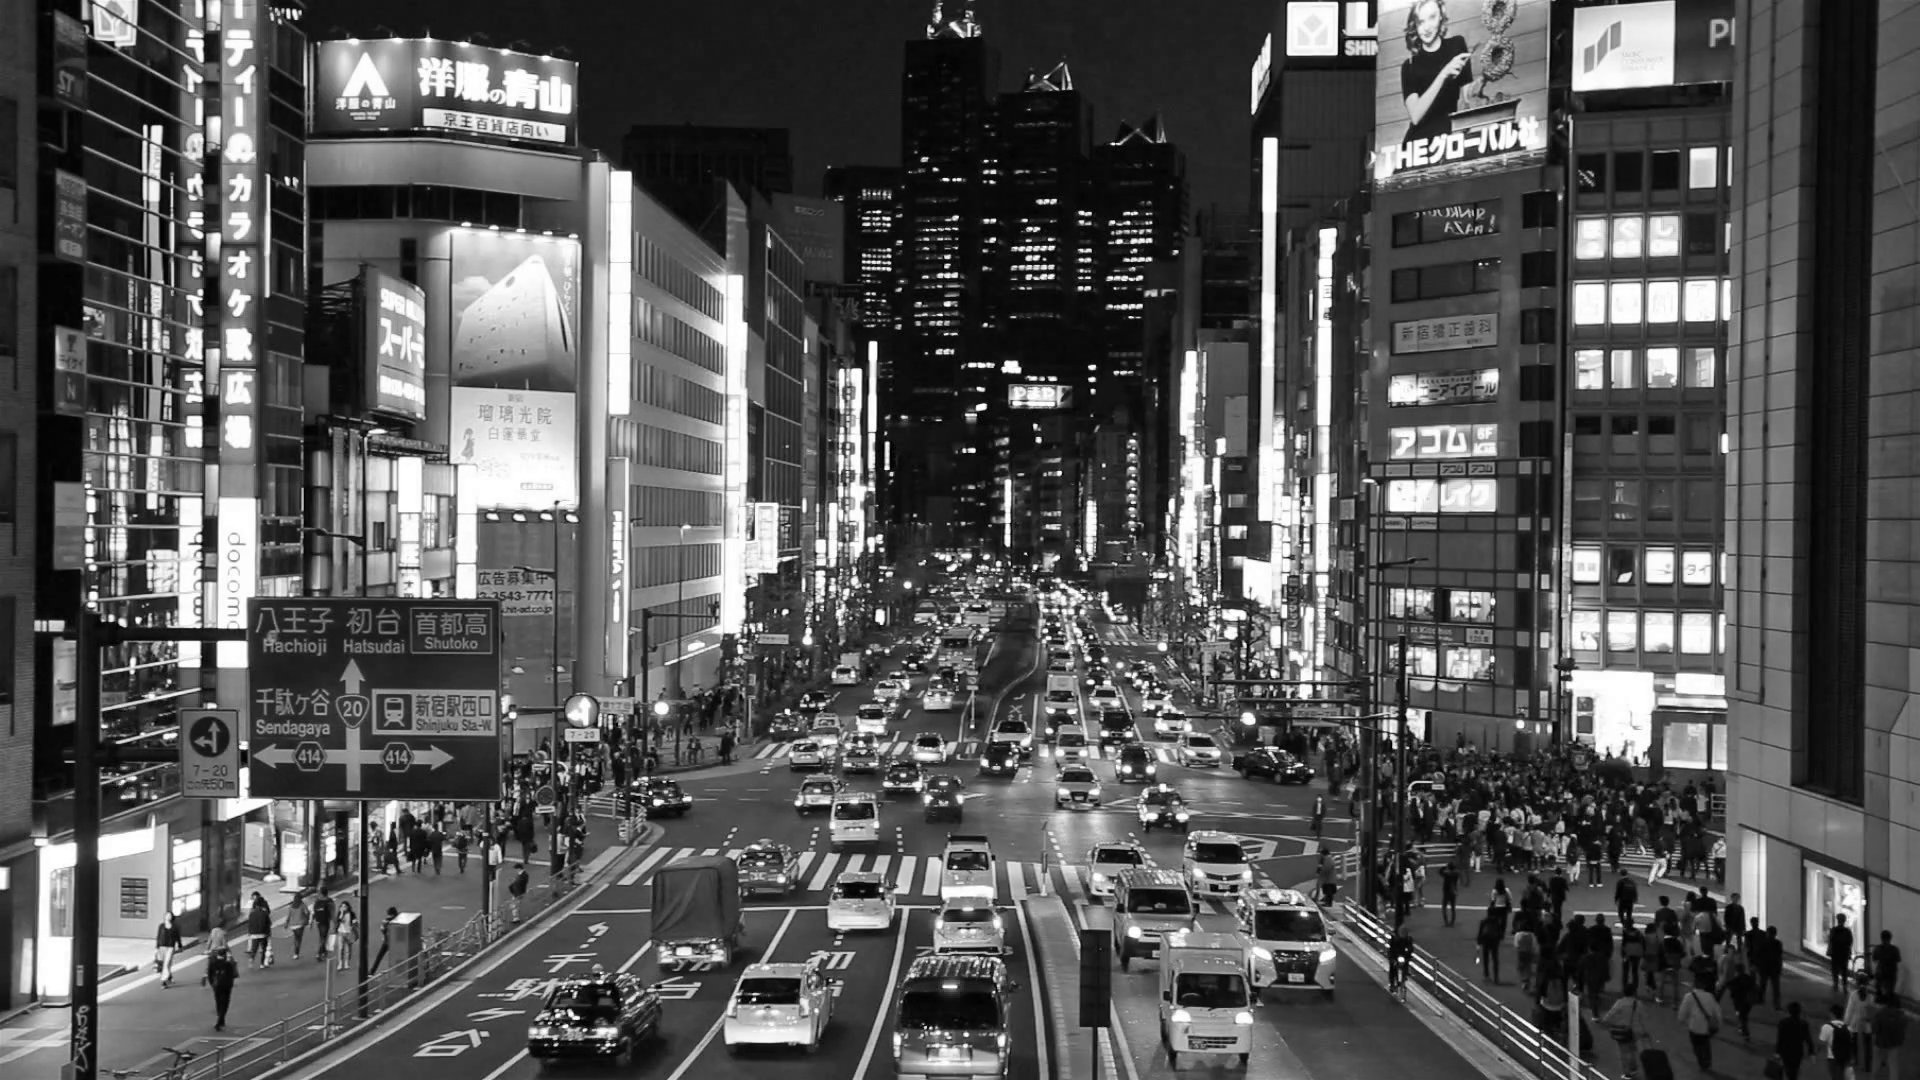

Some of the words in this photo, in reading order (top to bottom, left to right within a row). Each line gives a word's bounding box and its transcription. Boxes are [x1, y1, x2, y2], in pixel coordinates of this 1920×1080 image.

[417, 56, 573, 115] 洋服の青山
[443, 111, 550, 137] 京王百貨店向い
[1380, 115, 1540, 176] THEグローバル社
[478, 403, 552, 425] 瑠璃光院
[1395, 427, 1468, 457] アコム
[478, 571, 549, 586] 広告募集中
[255, 607, 334, 635] 八王子
[346, 607, 401, 636] 初台
[415, 612, 487, 636] 首都高
[263, 637, 328, 656] Hachioji
[343, 638, 406, 655] Hatsudai
[424, 636, 479, 650] Shutoko
[343, 701, 363, 718] 20
[415, 695, 493, 718] 新宿駅西口
[255, 719, 331, 738] Sendagaya
[416, 718, 459, 733] Shinjuku
[298, 749, 322, 764] 414
[384, 750, 408, 765] 414
